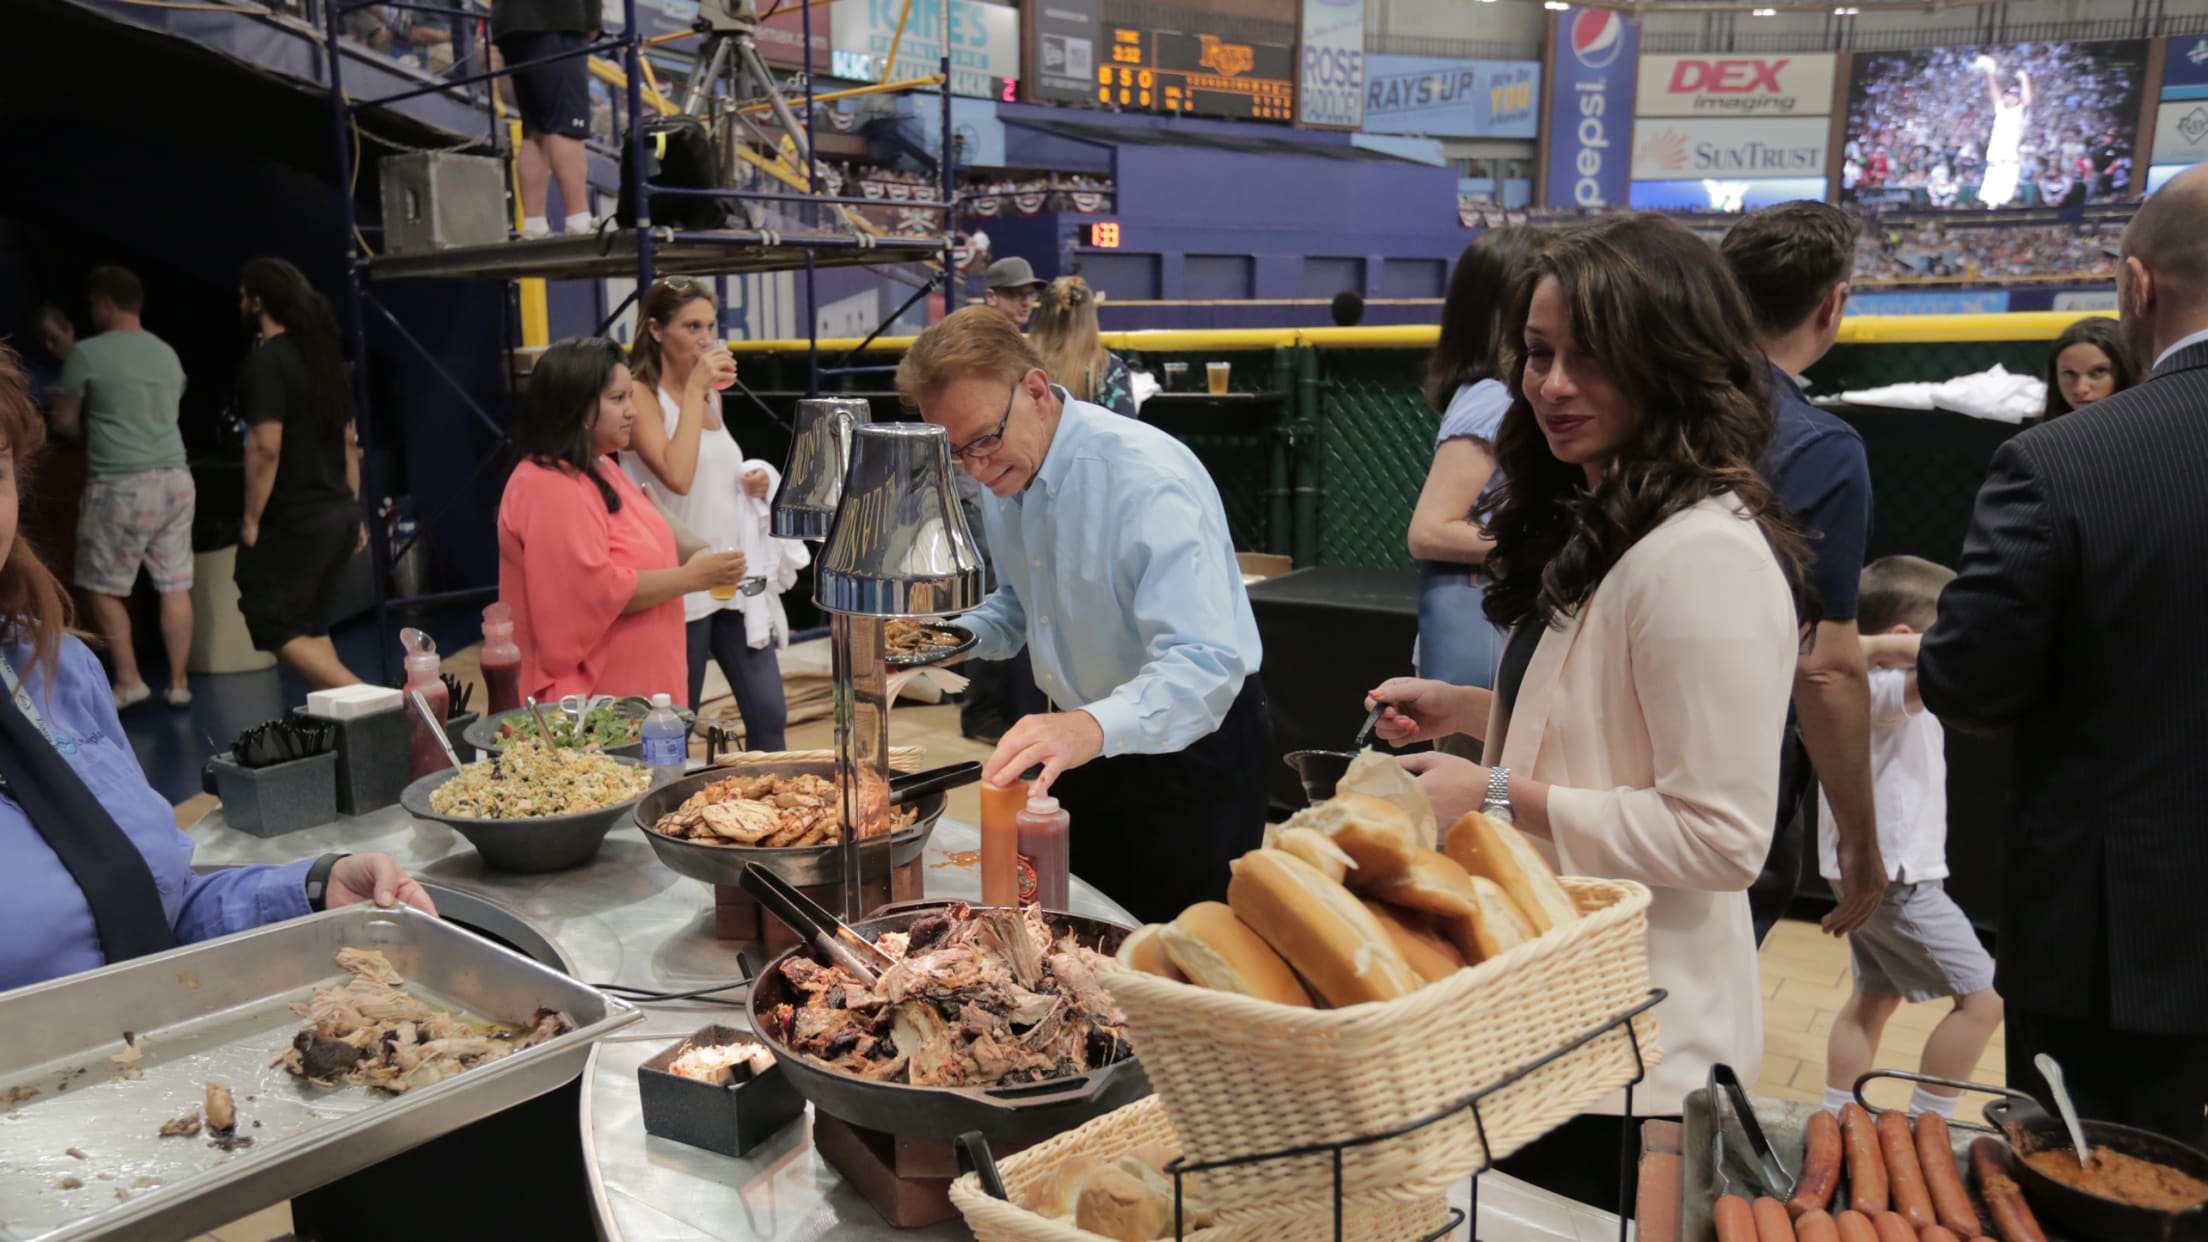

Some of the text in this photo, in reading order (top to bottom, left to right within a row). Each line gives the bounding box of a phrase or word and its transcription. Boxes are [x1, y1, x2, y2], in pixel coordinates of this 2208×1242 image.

[1302, 45, 1361, 88] ROSE
[1667, 59, 1791, 94] DEX
[1002, 77, 1016, 102] 2
[1367, 76, 1434, 110] RAYS
[1439, 71, 1474, 101] UP
[1693, 95, 1797, 112] imaging
[1574, 81, 1609, 208] pepsi
